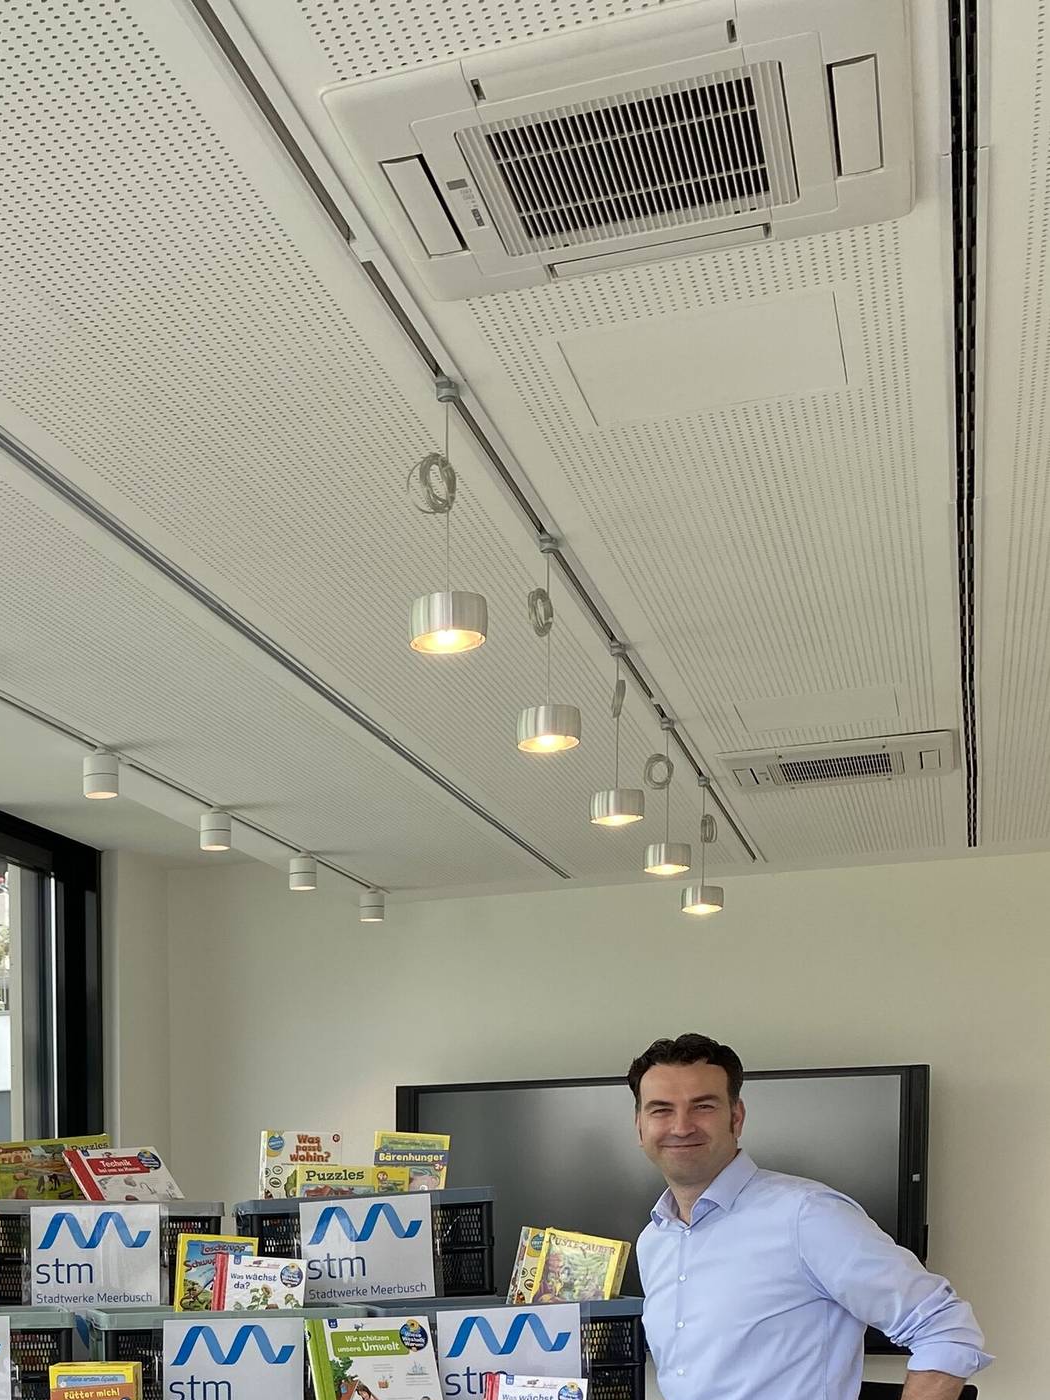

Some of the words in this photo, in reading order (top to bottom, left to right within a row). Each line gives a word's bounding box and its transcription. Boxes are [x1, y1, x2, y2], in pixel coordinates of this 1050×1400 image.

[297, 1134, 321, 1144] Was
[296, 1143, 322, 1153] passt
[289, 1151, 331, 1162] wohin?
[379, 1152, 445, 1163] Bärenhunger
[100, 1159, 132, 1168] Technik
[305, 1168, 365, 1182] Puzzles
[36, 1258, 93, 1285] stm
[308, 1253, 366, 1280] stm
[246, 1273, 278, 1281] wächst
[234, 1281, 250, 1289] da?
[309, 1287, 368, 1300] Stadtwerke
[371, 1282, 427, 1295] Meerbusch
[36, 1293, 93, 1304] Stadtwerke
[97, 1292, 153, 1303] Meerbusch
[362, 1341, 400, 1352] Umwelt
[64, 1391, 95, 1399] Fütter
[96, 1388, 120, 1397] mich!
